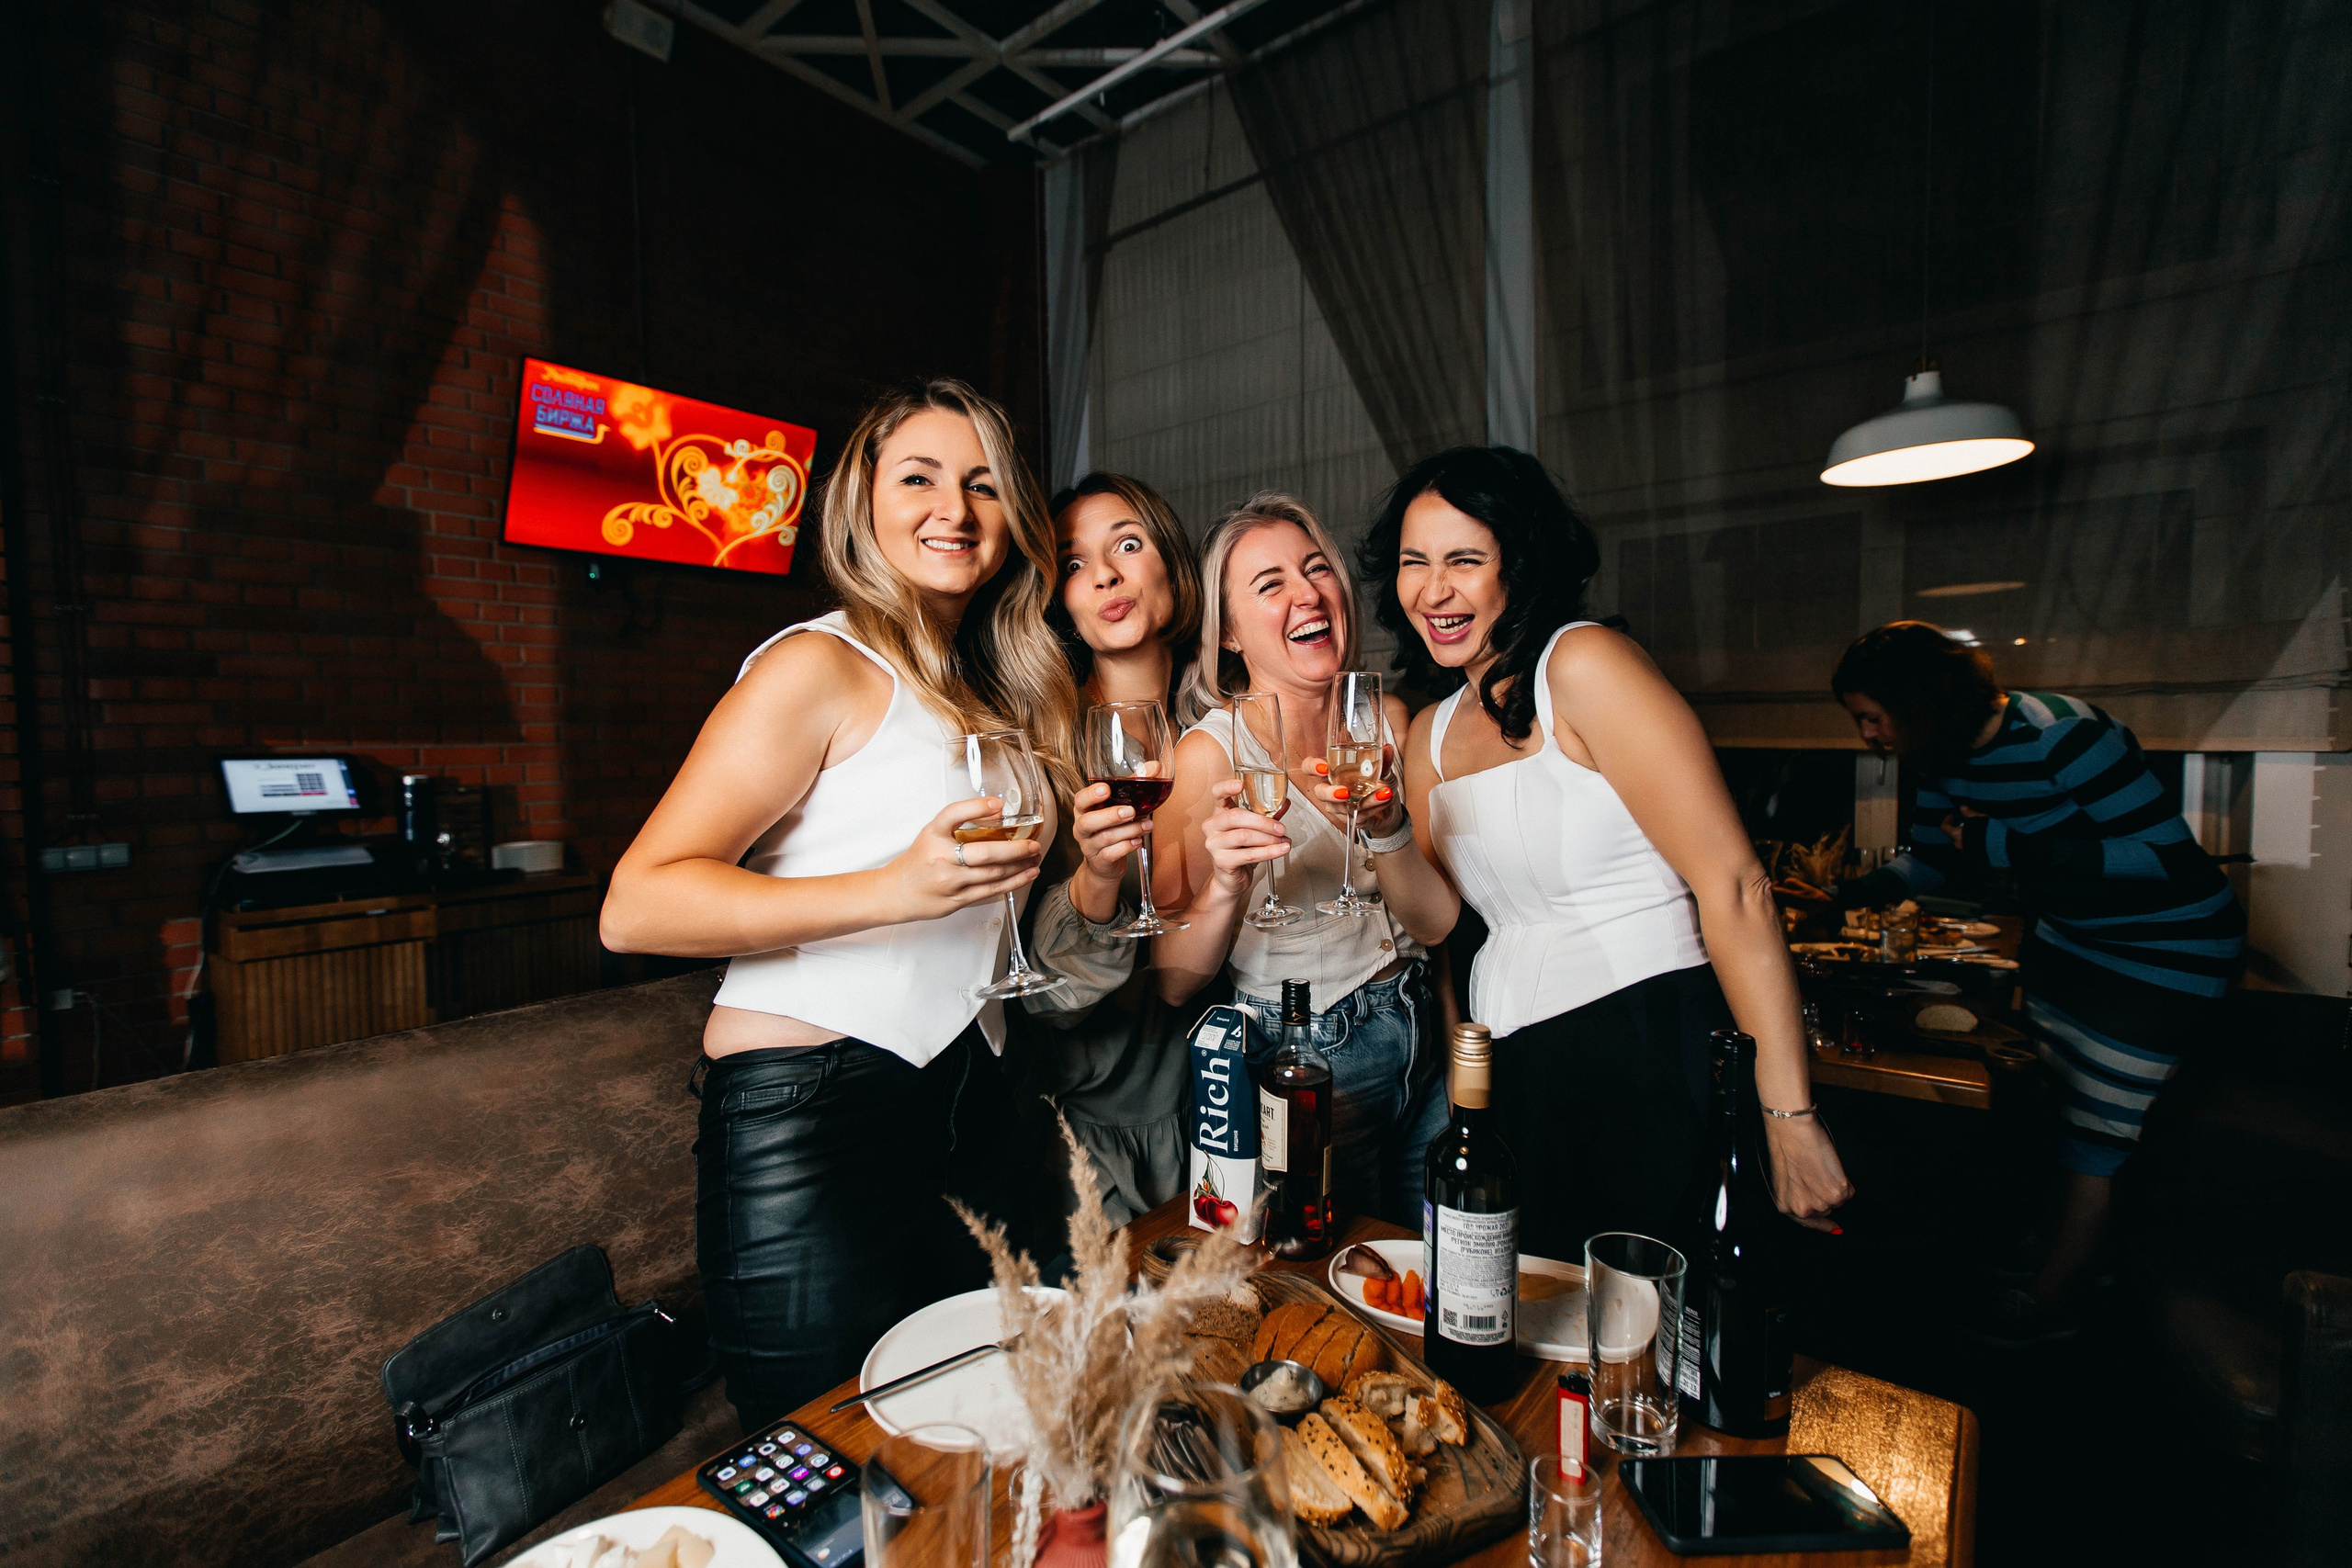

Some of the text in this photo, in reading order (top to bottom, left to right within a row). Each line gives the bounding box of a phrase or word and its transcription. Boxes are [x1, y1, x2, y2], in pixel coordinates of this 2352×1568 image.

[535, 403, 594, 433] БИРЖА
[1199, 1057, 1230, 1154] Rich
[1441, 1226, 1455, 1236] МЕСТО
[1456, 1231, 1502, 1242] ПРОИСХОЖДЕНИЯ
[1451, 1236, 1472, 1247] РЕГИОН
